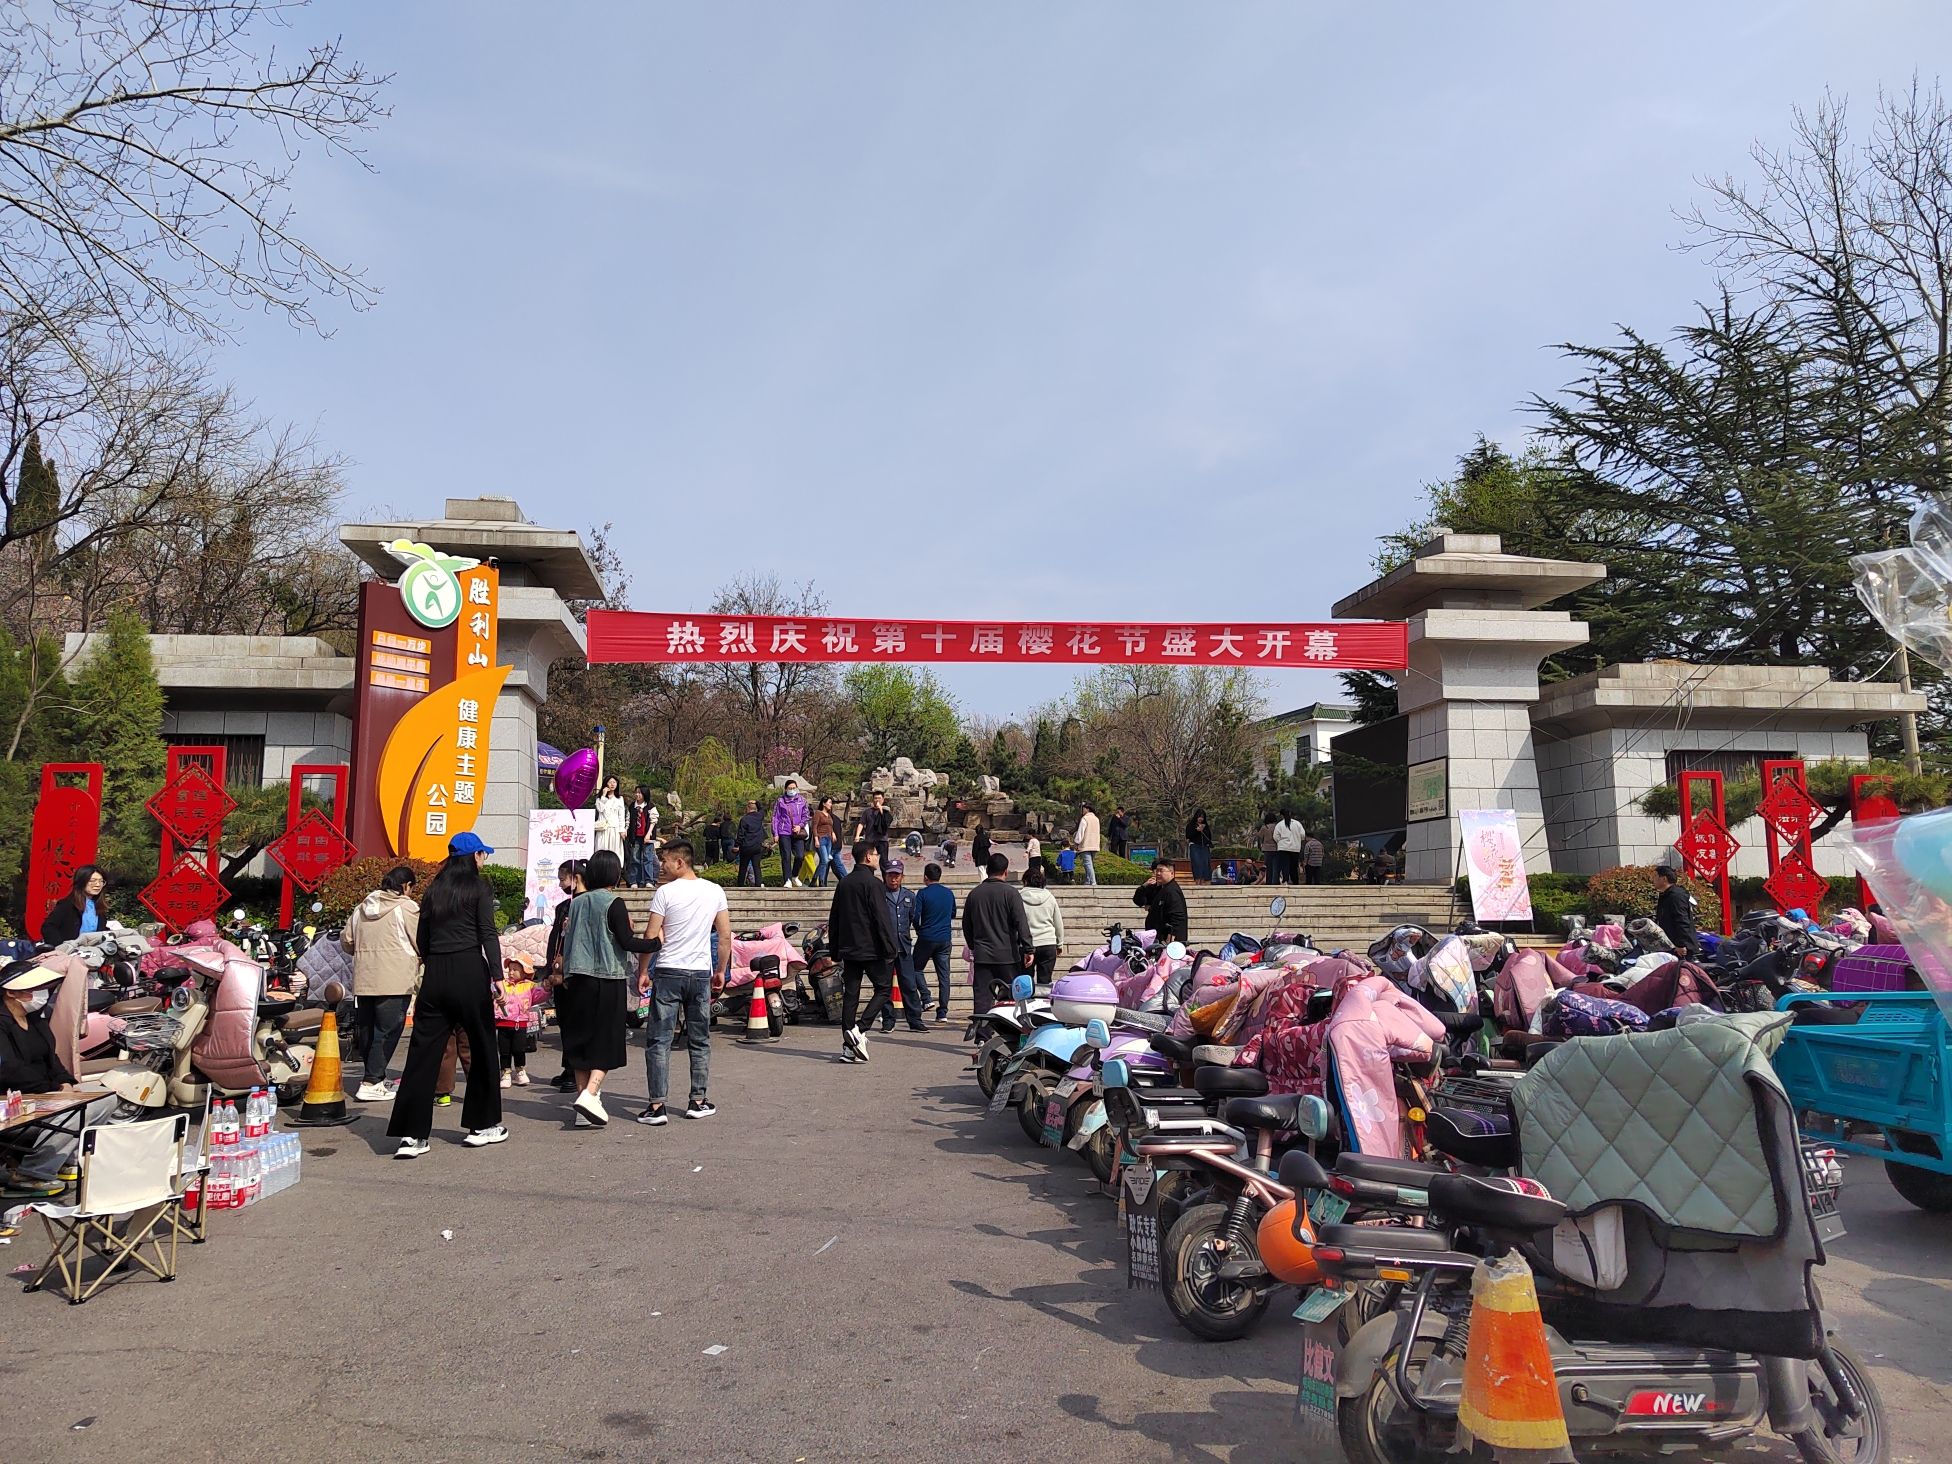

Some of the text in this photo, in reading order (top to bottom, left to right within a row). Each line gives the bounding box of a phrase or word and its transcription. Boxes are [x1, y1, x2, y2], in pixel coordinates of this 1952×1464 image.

[468, 577, 491, 667] 胜利山
[666, 621, 1339, 661] 热烈庆祝第十届樱花节盛大开幕
[453, 698, 479, 804] 健康主题
[425, 783, 449, 836] 公园
[540, 825, 587, 844] 赏樱花
[1653, 1393, 1706, 1413] NEW
